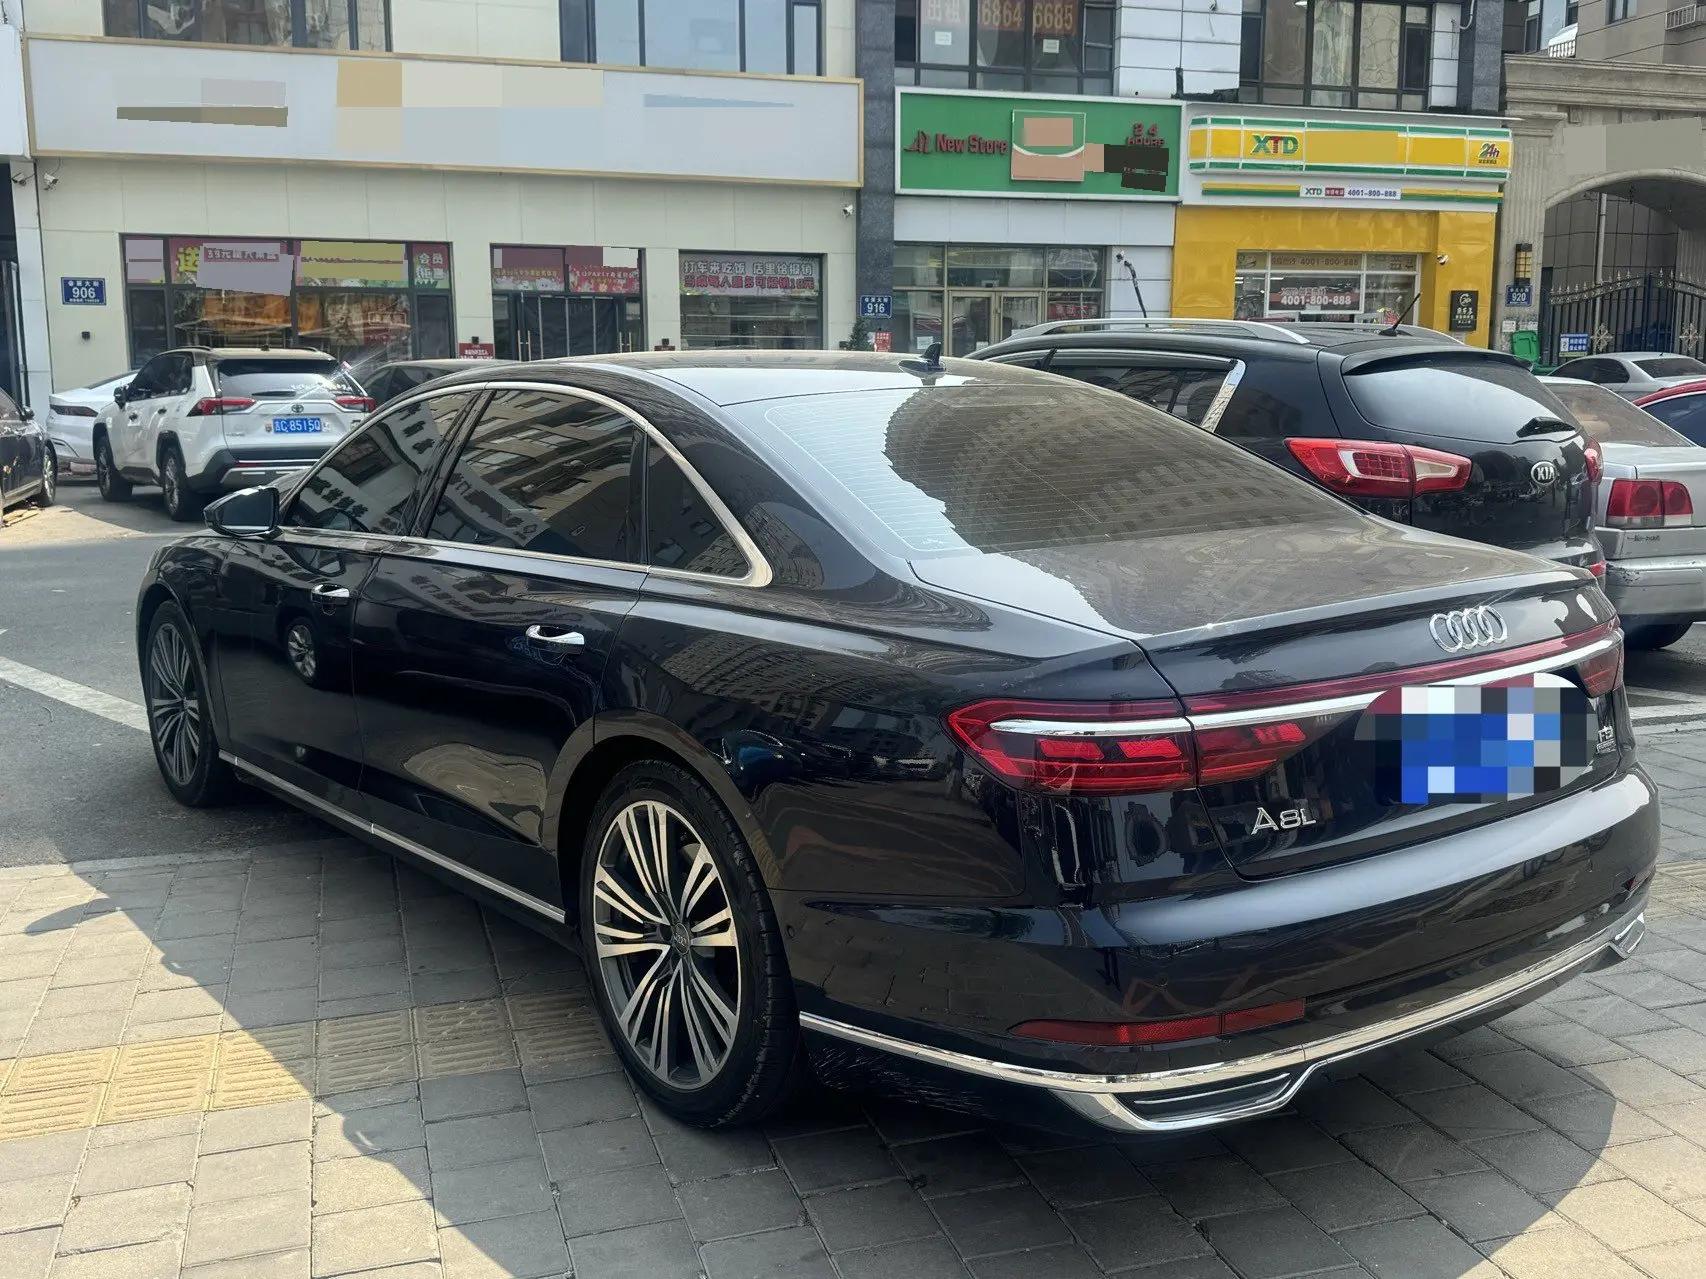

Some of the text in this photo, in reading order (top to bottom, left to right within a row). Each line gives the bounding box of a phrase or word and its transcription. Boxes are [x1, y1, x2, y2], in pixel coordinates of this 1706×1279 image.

[936, 134, 1008, 154] New Store
[1250, 134, 1299, 155] XTD
[1348, 189, 1397, 197] 4001-800-888
[684, 261, 813, 275] 打车来吃饭 店里给报销
[72, 287, 96, 299] 906
[1512, 292, 1526, 302] 920
[1280, 295, 1352, 306] 4001-800-888
[867, 303, 885, 313] 916
[1536, 466, 1556, 480] KIA
[1250, 806, 1317, 836] A8L
